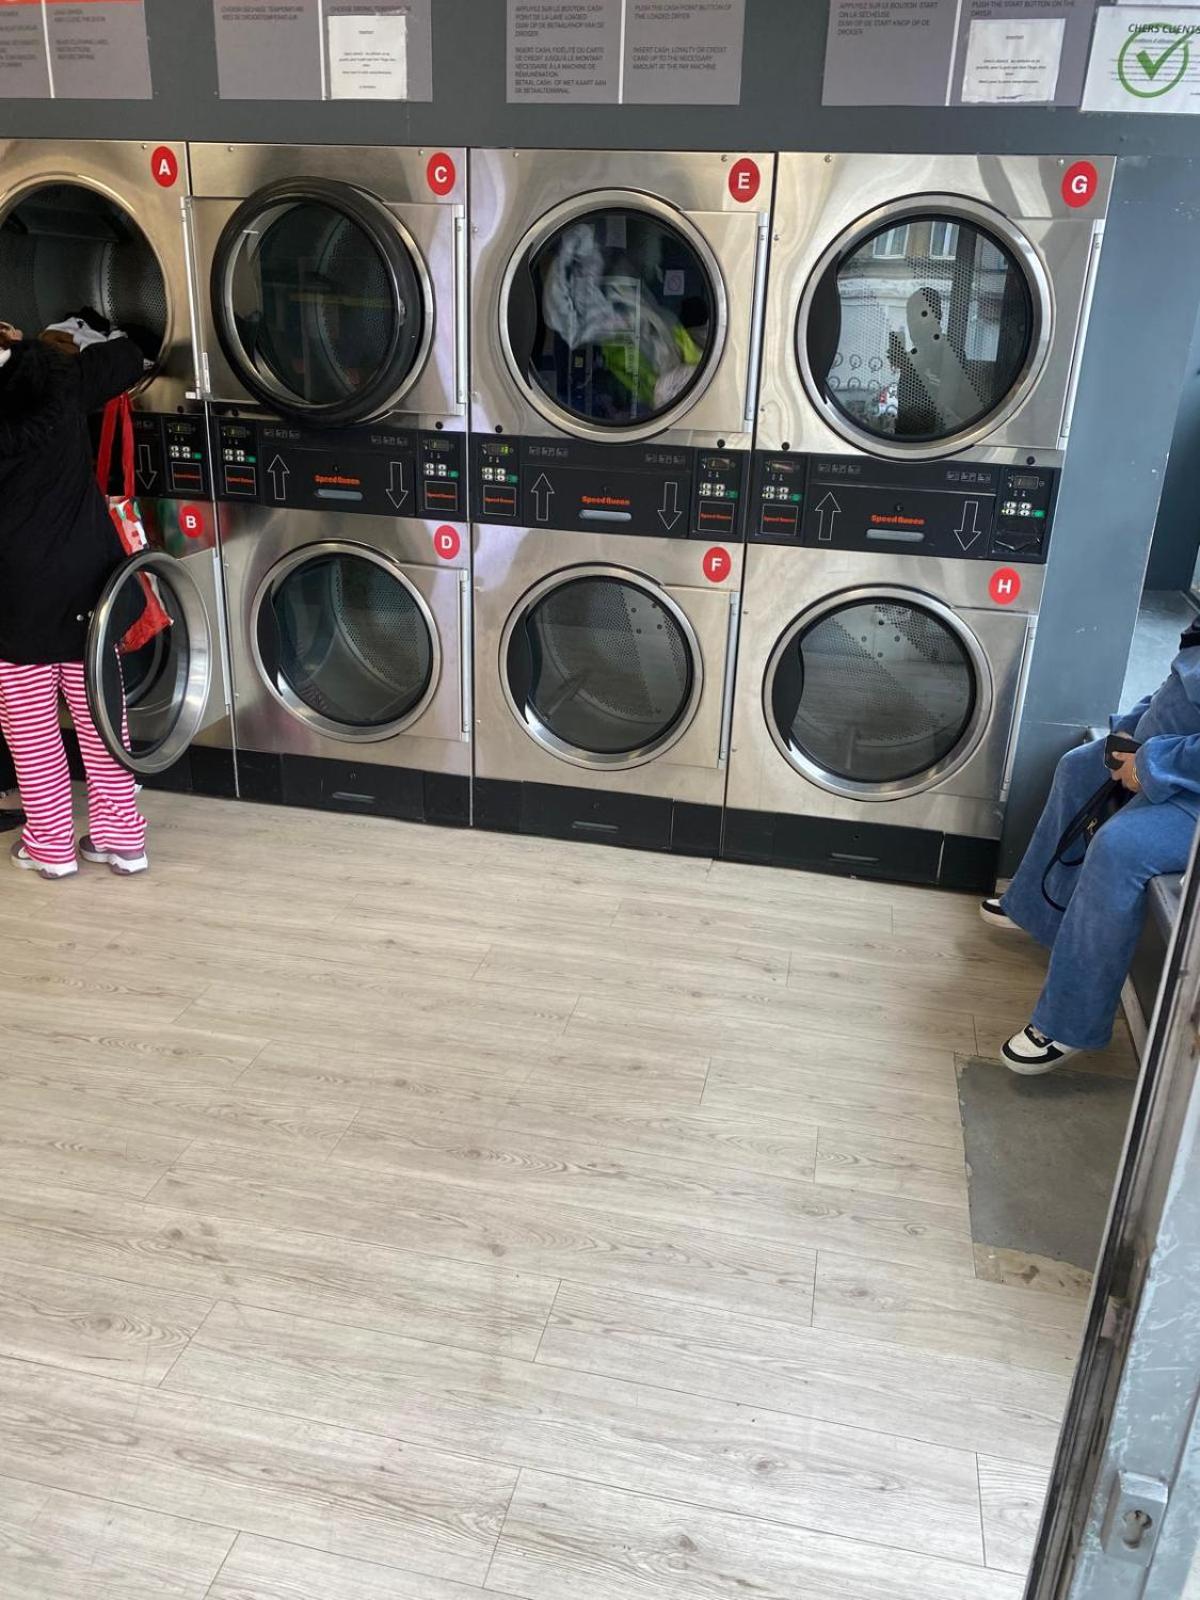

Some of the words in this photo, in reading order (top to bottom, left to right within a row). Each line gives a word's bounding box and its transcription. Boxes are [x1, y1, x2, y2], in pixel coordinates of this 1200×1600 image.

[1127, 23, 1160, 34] CHERS
[158, 158, 171, 176] A
[434, 165, 447, 183] C
[737, 172, 750, 190] E
[1071, 174, 1088, 194] G
[582, 496, 606, 505] Speed
[185, 515, 197, 529] B
[872, 514, 897, 524] Speed
[441, 535, 453, 550] D
[711, 557, 723, 572] F
[997, 578, 1012, 594] H
